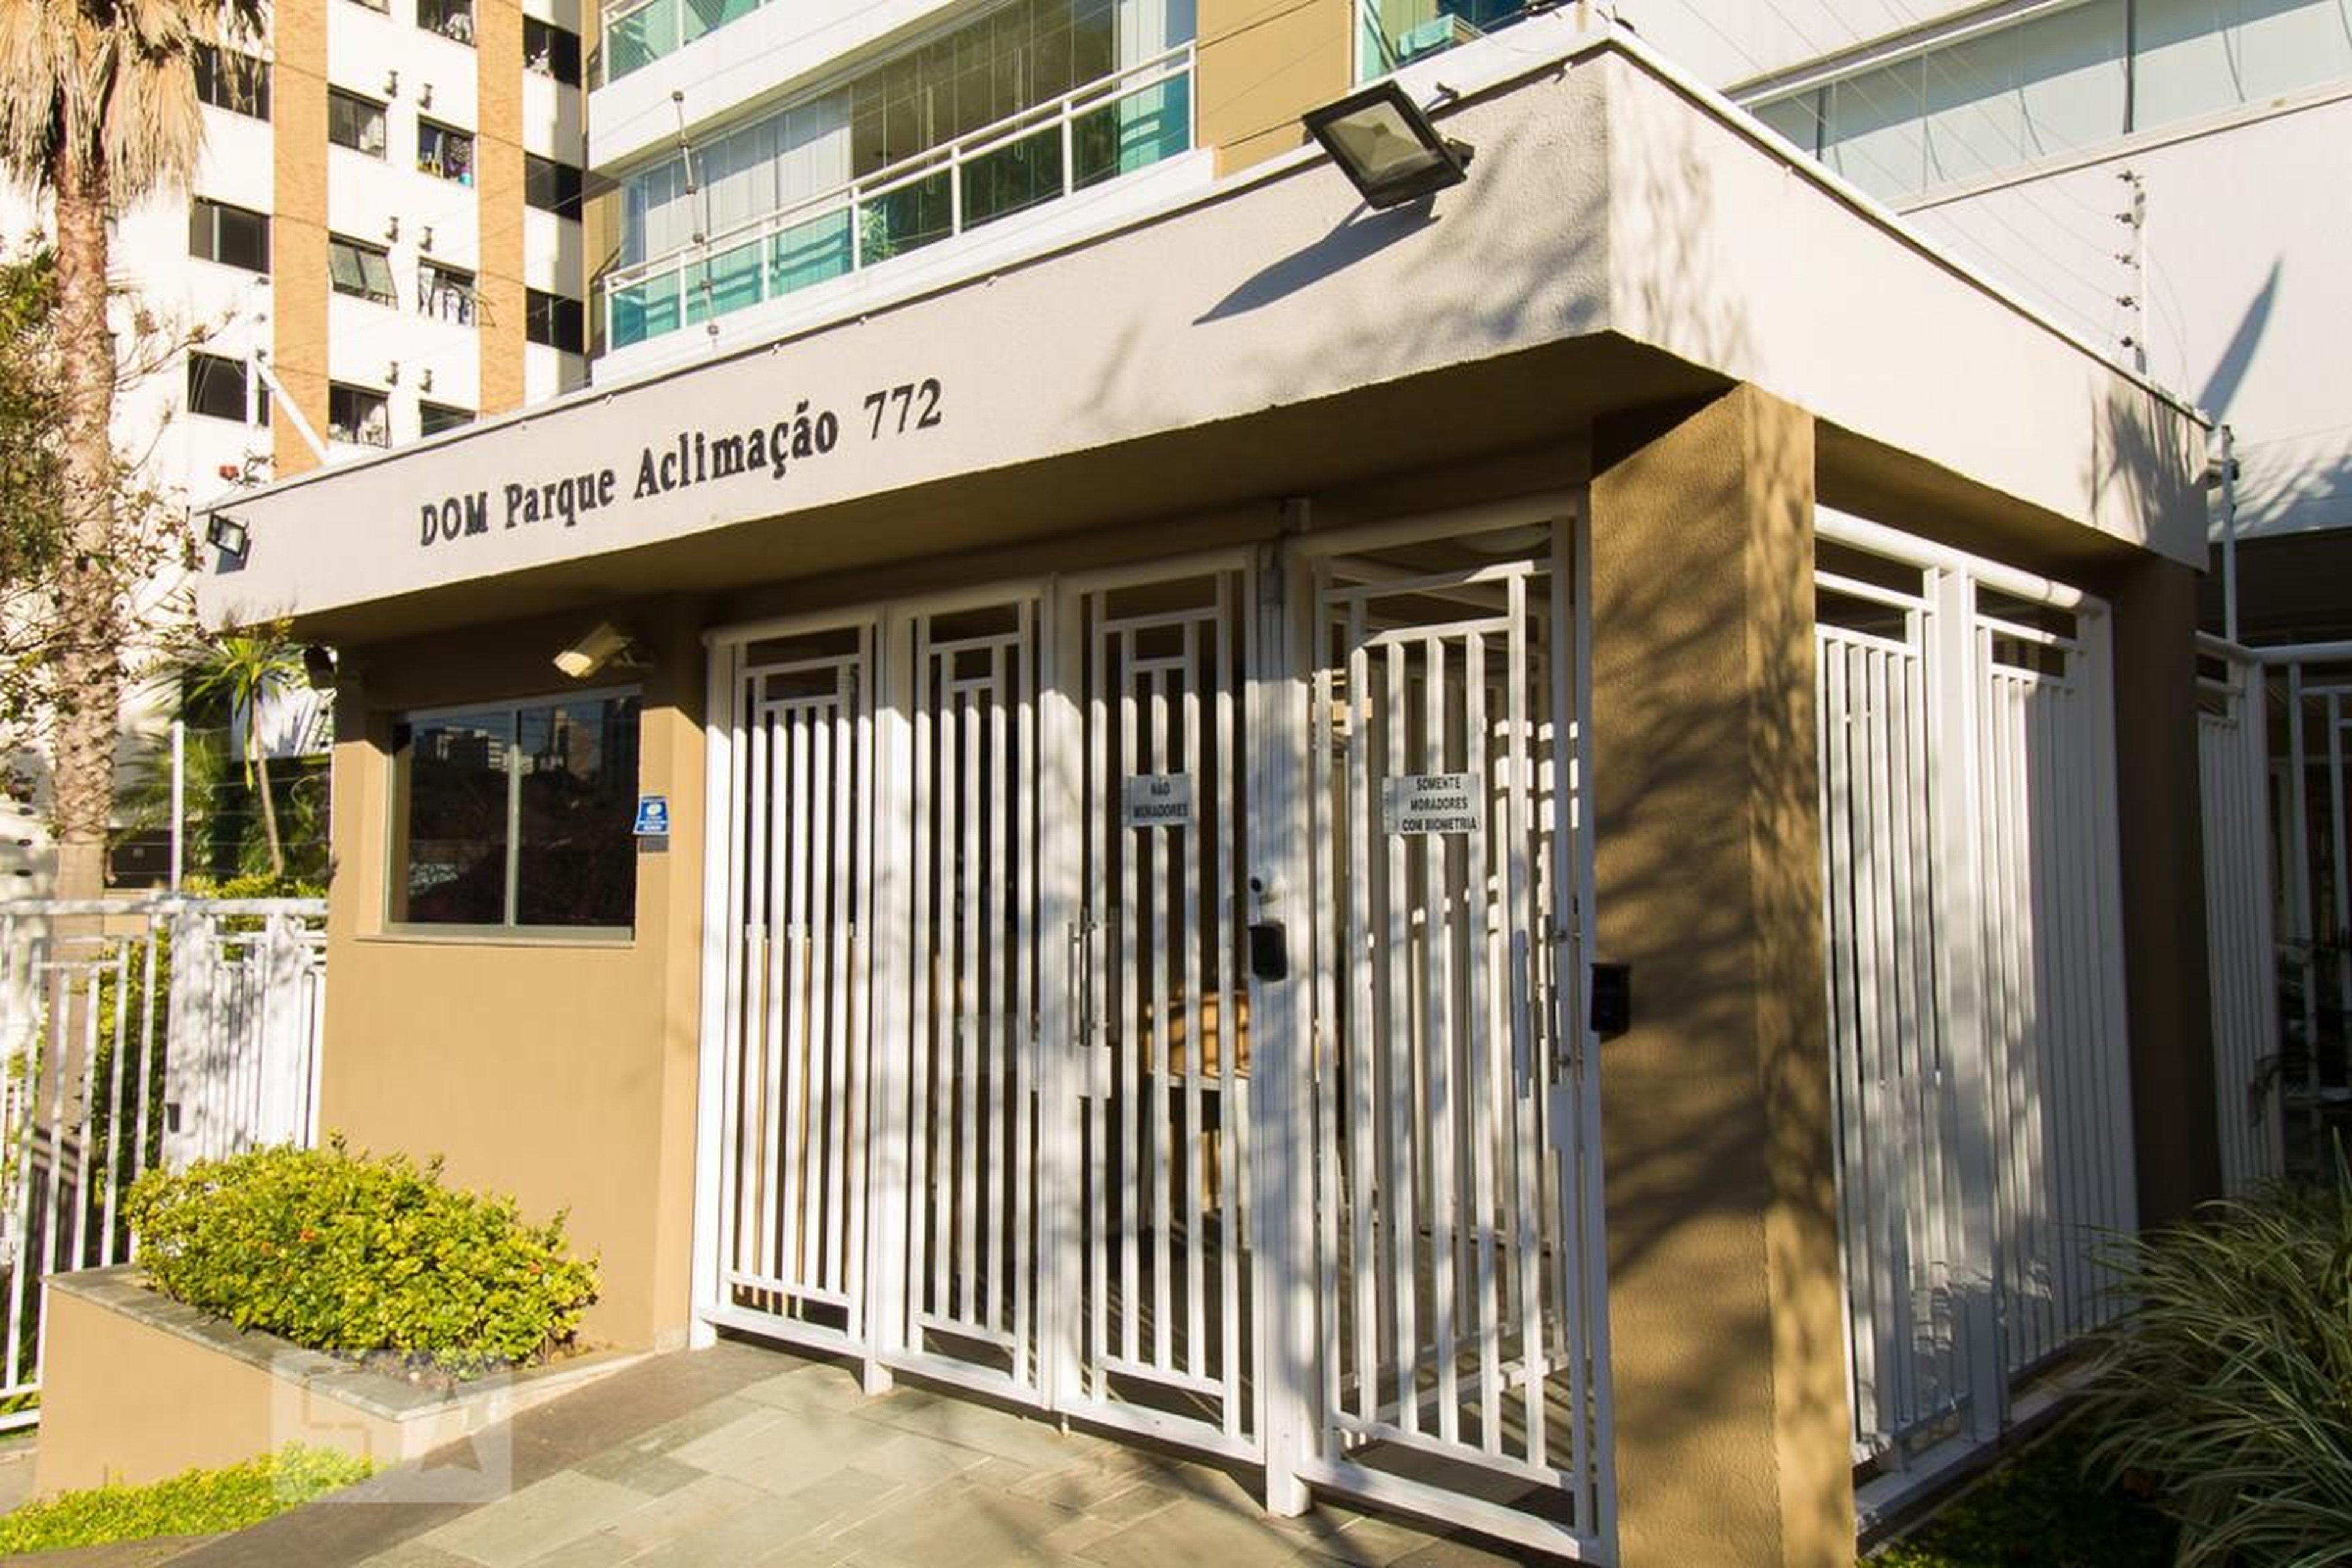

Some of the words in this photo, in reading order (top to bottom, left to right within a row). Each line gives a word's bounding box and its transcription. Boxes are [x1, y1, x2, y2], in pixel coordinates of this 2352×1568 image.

[420, 489, 489, 546] DOM
[505, 467, 614, 530] Parque
[633, 399, 839, 498] Aclimação
[864, 377, 943, 441] 772
[1416, 776, 1461, 791] SOMENTE
[1133, 803, 1188, 818] MORADORES
[1410, 797, 1468, 811] MORADORES
[1402, 818, 1423, 831] COM
[1425, 816, 1477, 831] BIOMETRIA
